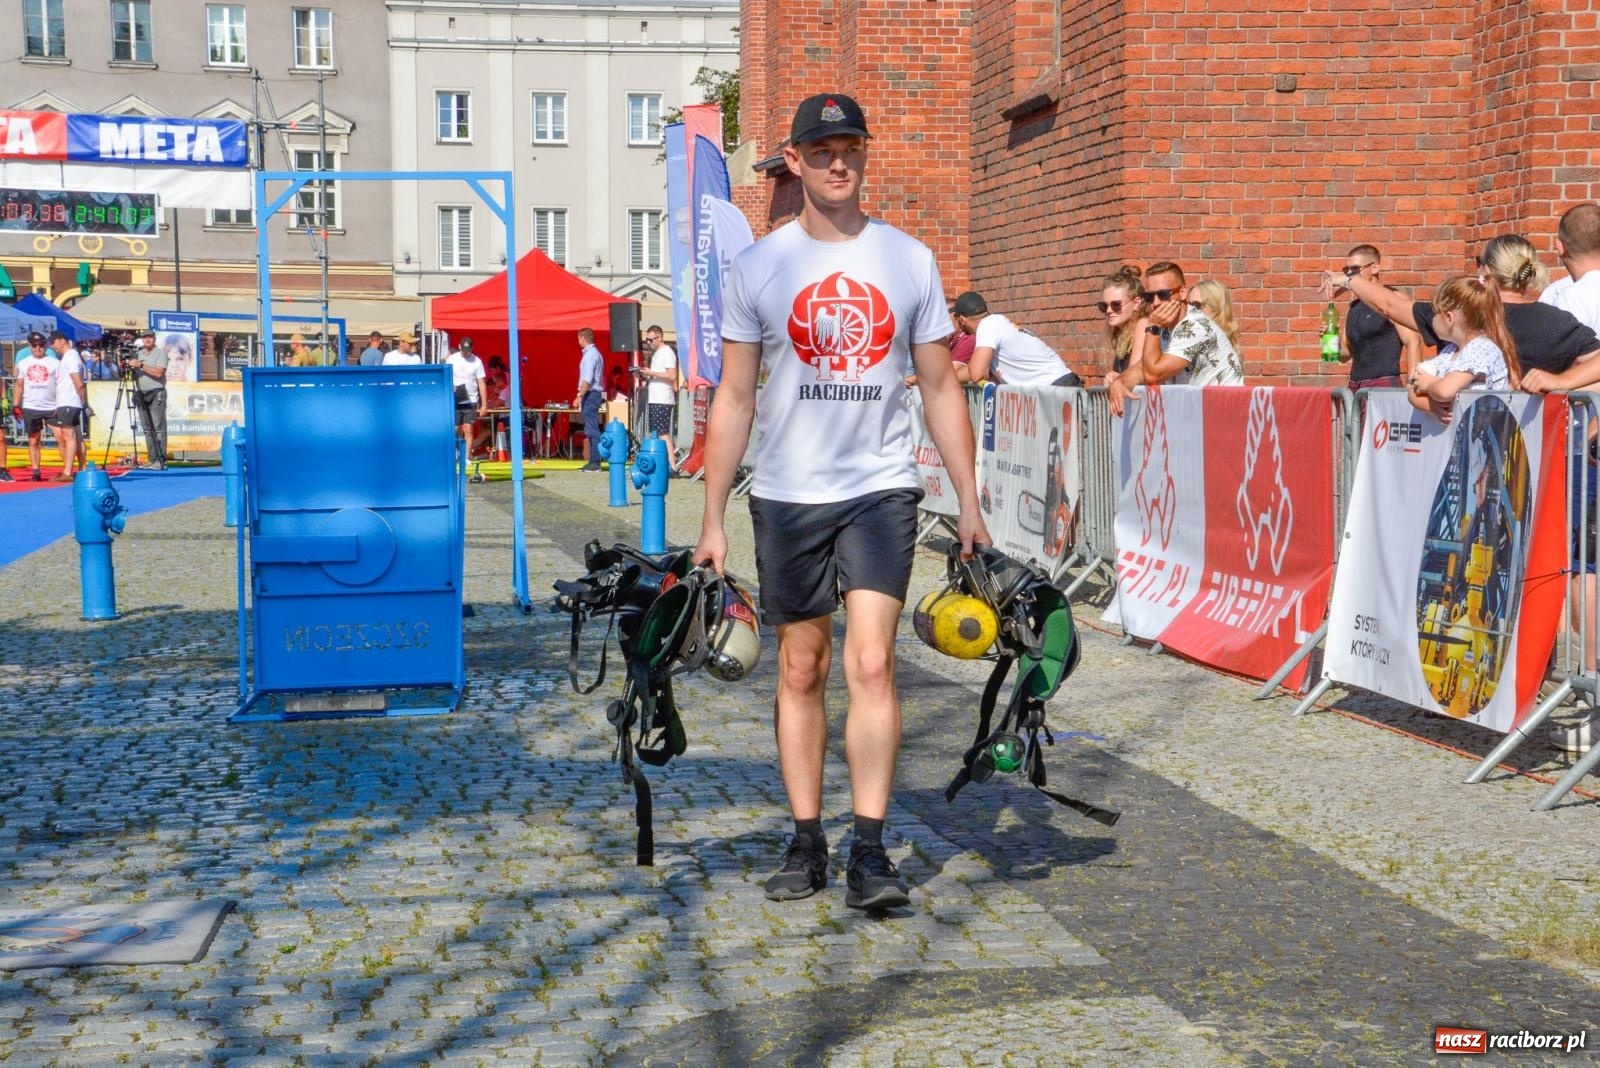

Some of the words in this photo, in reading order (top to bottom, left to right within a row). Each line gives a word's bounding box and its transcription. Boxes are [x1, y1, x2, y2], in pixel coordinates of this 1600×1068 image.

[99, 122, 224, 163] META
[799, 383, 882, 401] RACIBÓRZ
[1354, 614, 1379, 635] SYSTE
